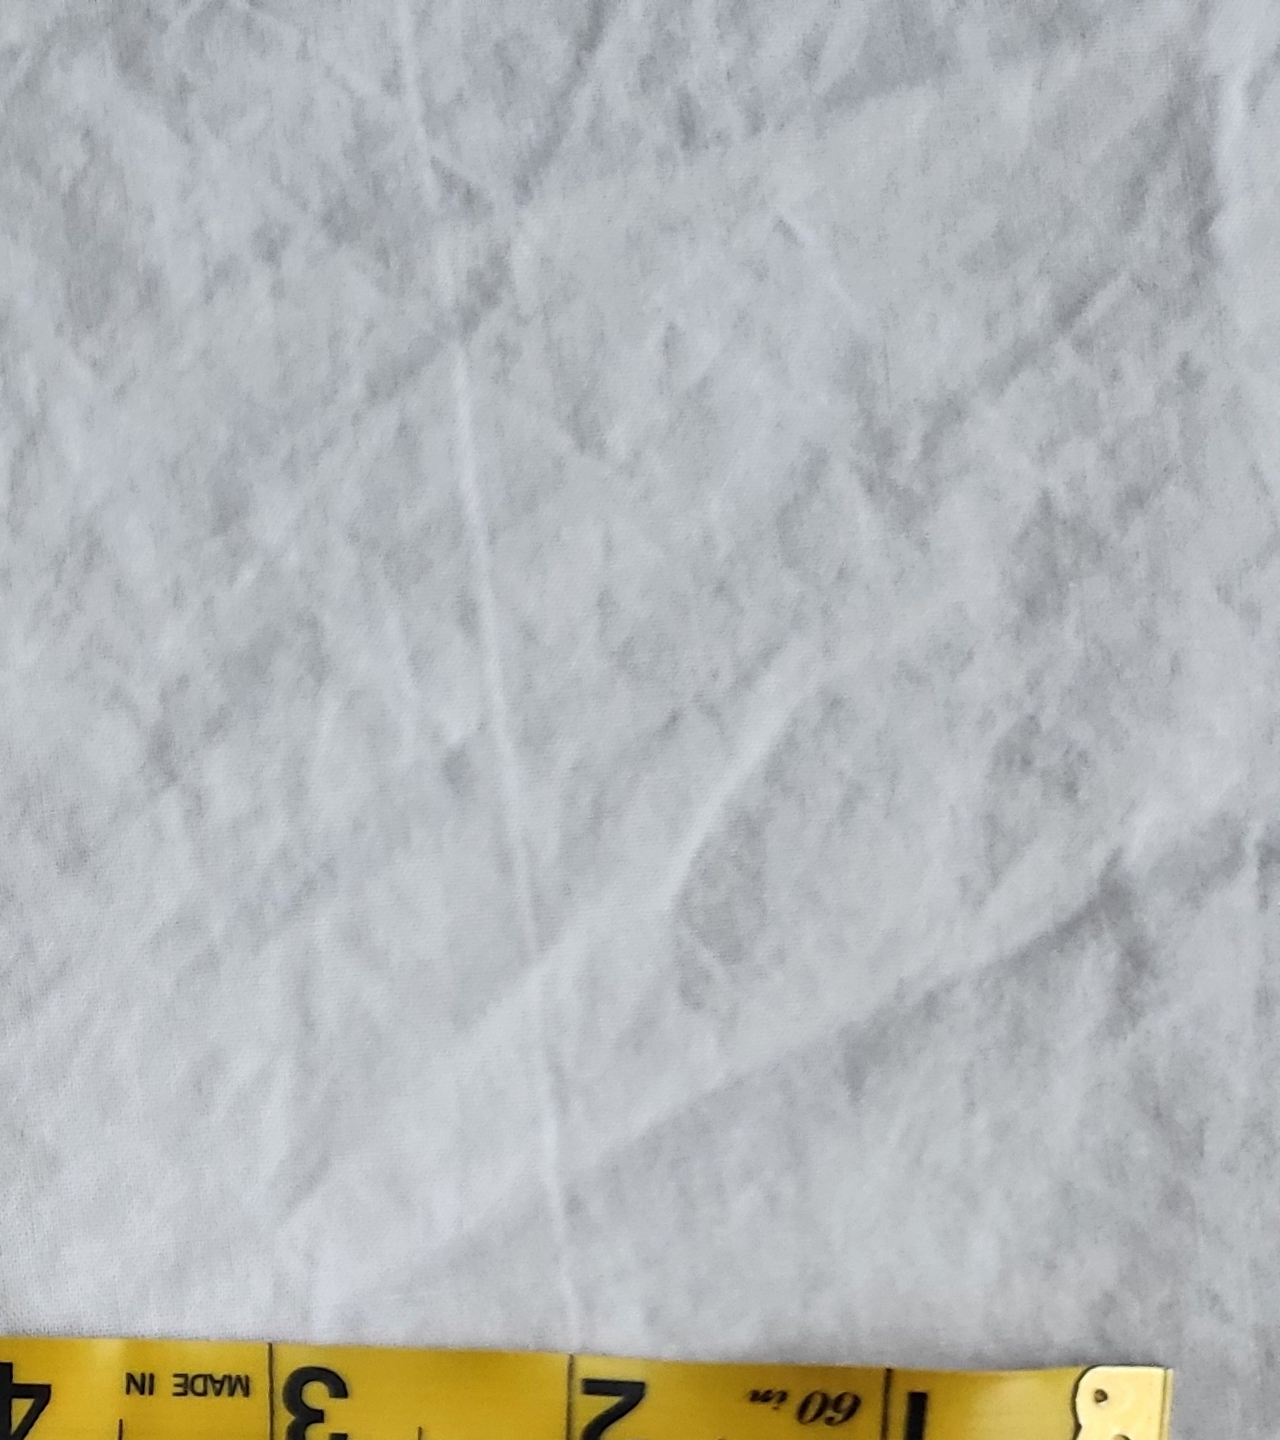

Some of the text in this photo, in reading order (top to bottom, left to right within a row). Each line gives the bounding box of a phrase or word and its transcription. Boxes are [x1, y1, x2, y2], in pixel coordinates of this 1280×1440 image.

[124, 1371, 251, 1399] MADE IN
[747, 1388, 863, 1427] 60 in
